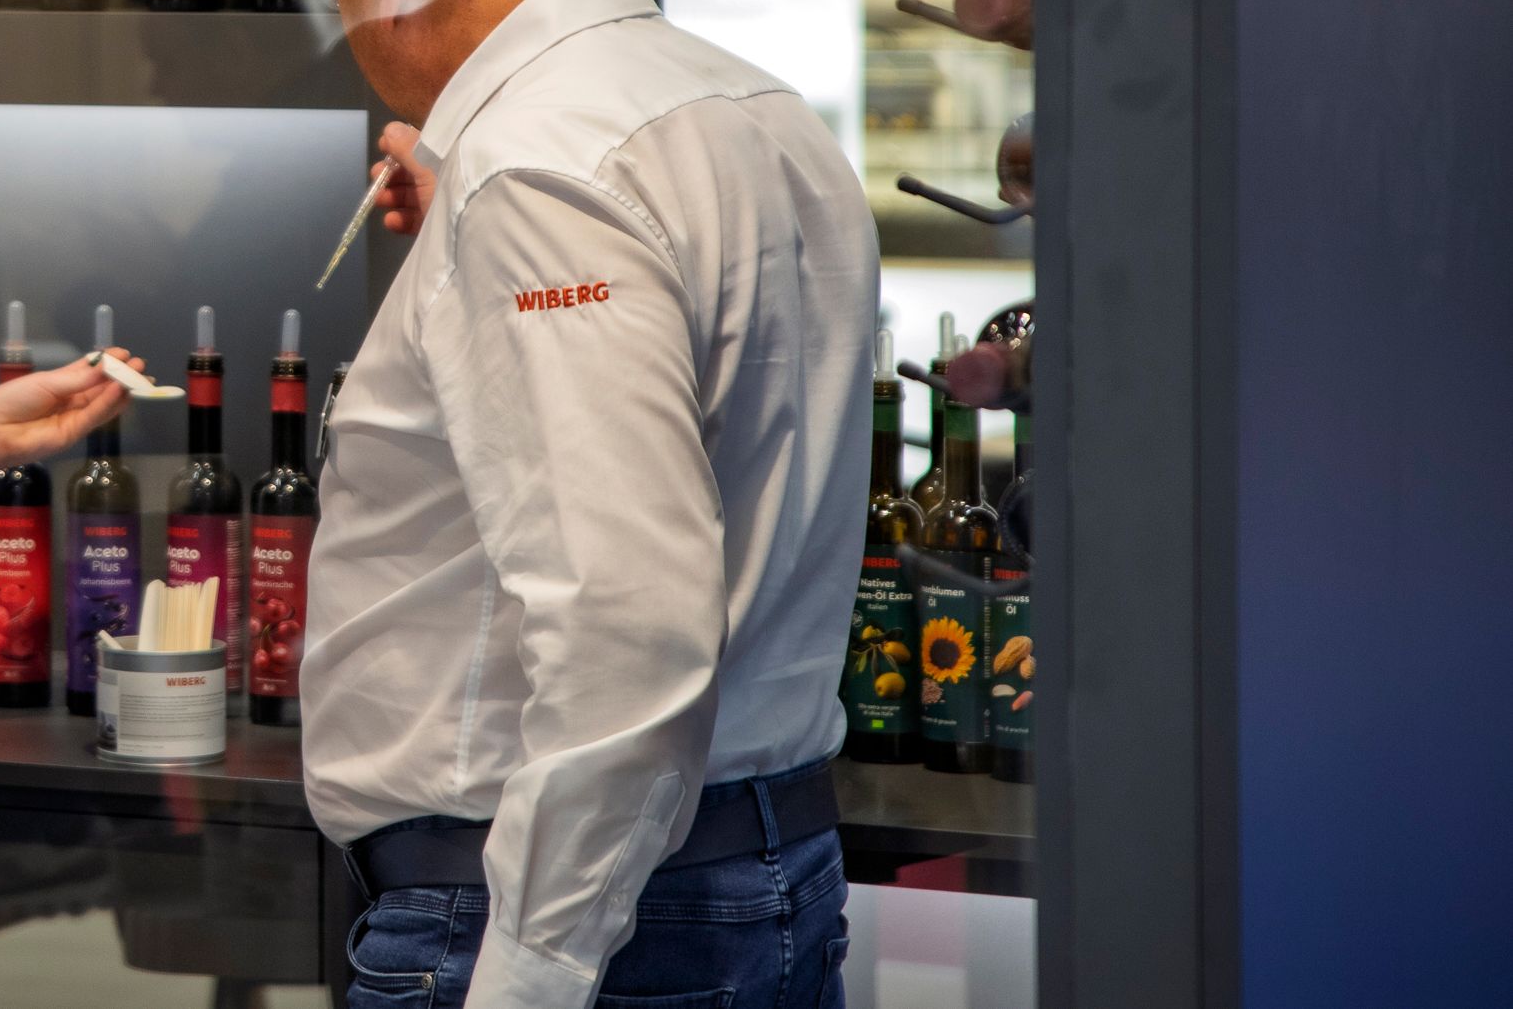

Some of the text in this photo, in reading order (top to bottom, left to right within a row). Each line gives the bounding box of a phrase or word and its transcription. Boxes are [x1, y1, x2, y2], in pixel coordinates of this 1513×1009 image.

[515, 280, 609, 312] WIBERG
[83, 545, 129, 561] Aceto
[253, 546, 294, 562] Aceto
[92, 561, 121, 574] Plus
[170, 561, 192, 575] Plus
[258, 561, 285, 576] Plus
[860, 578, 897, 589] Natives
[857, 590, 913, 601] ven-Öl Extra
[1005, 603, 1017, 615] Öl
[166, 676, 207, 687] WIBERG
